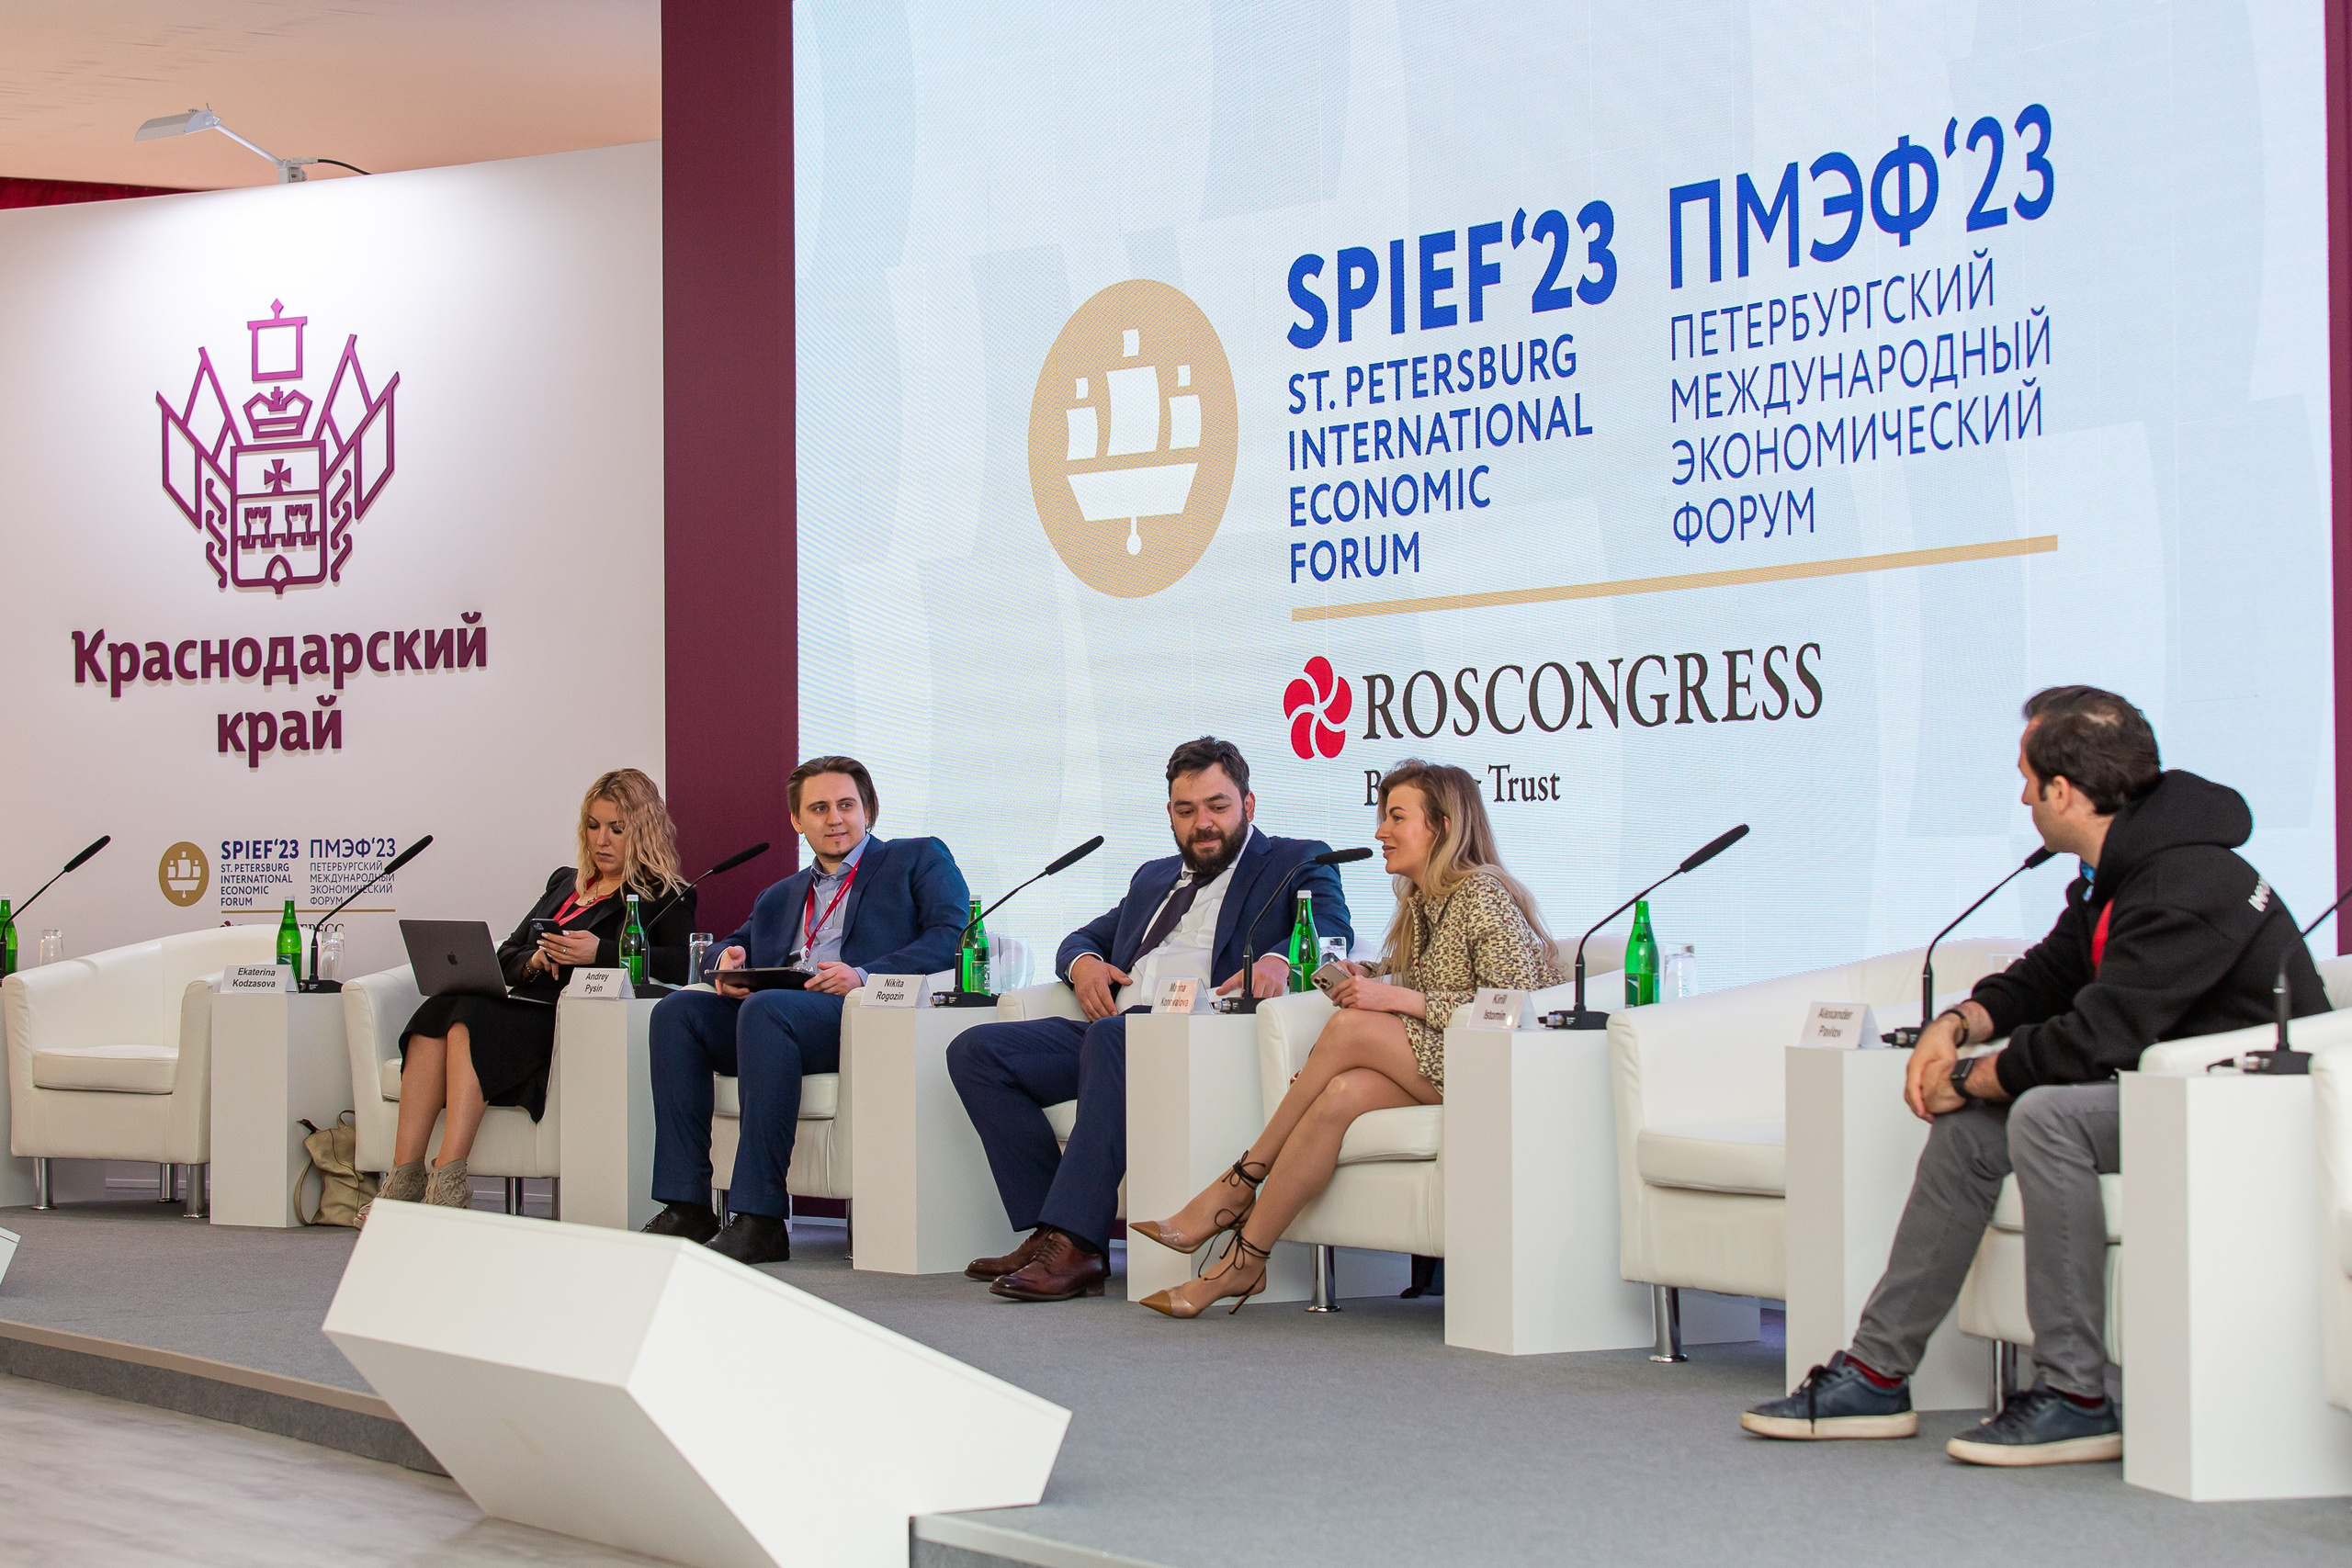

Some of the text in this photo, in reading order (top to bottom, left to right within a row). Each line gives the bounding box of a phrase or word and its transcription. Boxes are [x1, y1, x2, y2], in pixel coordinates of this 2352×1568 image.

[1671, 247, 1994, 361] ПЕТЕРБУРГСКИЙ
[1672, 306, 2051, 423] МЕЖДУНАРОДНЫЙ
[1288, 333, 1577, 414] ST. PETERSBURG
[1289, 392, 1593, 471] INTERNATIONAL
[1672, 377, 2042, 485] ЭКОНОМИЧЕСКИЙ
[1290, 465, 1491, 527] ECONOMIC
[1673, 487, 1815, 547] ФОРУМ
[1291, 531, 1419, 583] FORUM
[72, 611, 487, 698] Краснодарский
[1363, 642, 1823, 740] ROSCONGRESS
[217, 694, 342, 768] край
[1487, 763, 1561, 802] Trust
[220, 863, 289, 873] ST. PETERSBURG
[310, 860, 383, 872] ПЕТЕРБУРГСКИЙ
[220, 874, 293, 884] INTERNATIONAL
[220, 886, 269, 896] ECONOMIC
[220, 897, 253, 907] FORUM
[310, 897, 344, 906] ФОРУМ
[237, 967, 276, 976] Ekaterina
[585, 973, 609, 982] Andrey
[232, 978, 276, 987] Kodzasova
[884, 978, 905, 988] Nikita
[1170, 982, 1187, 993] Maina
[584, 984, 603, 994] Pysin
[876, 991, 904, 1002] Rogozin
